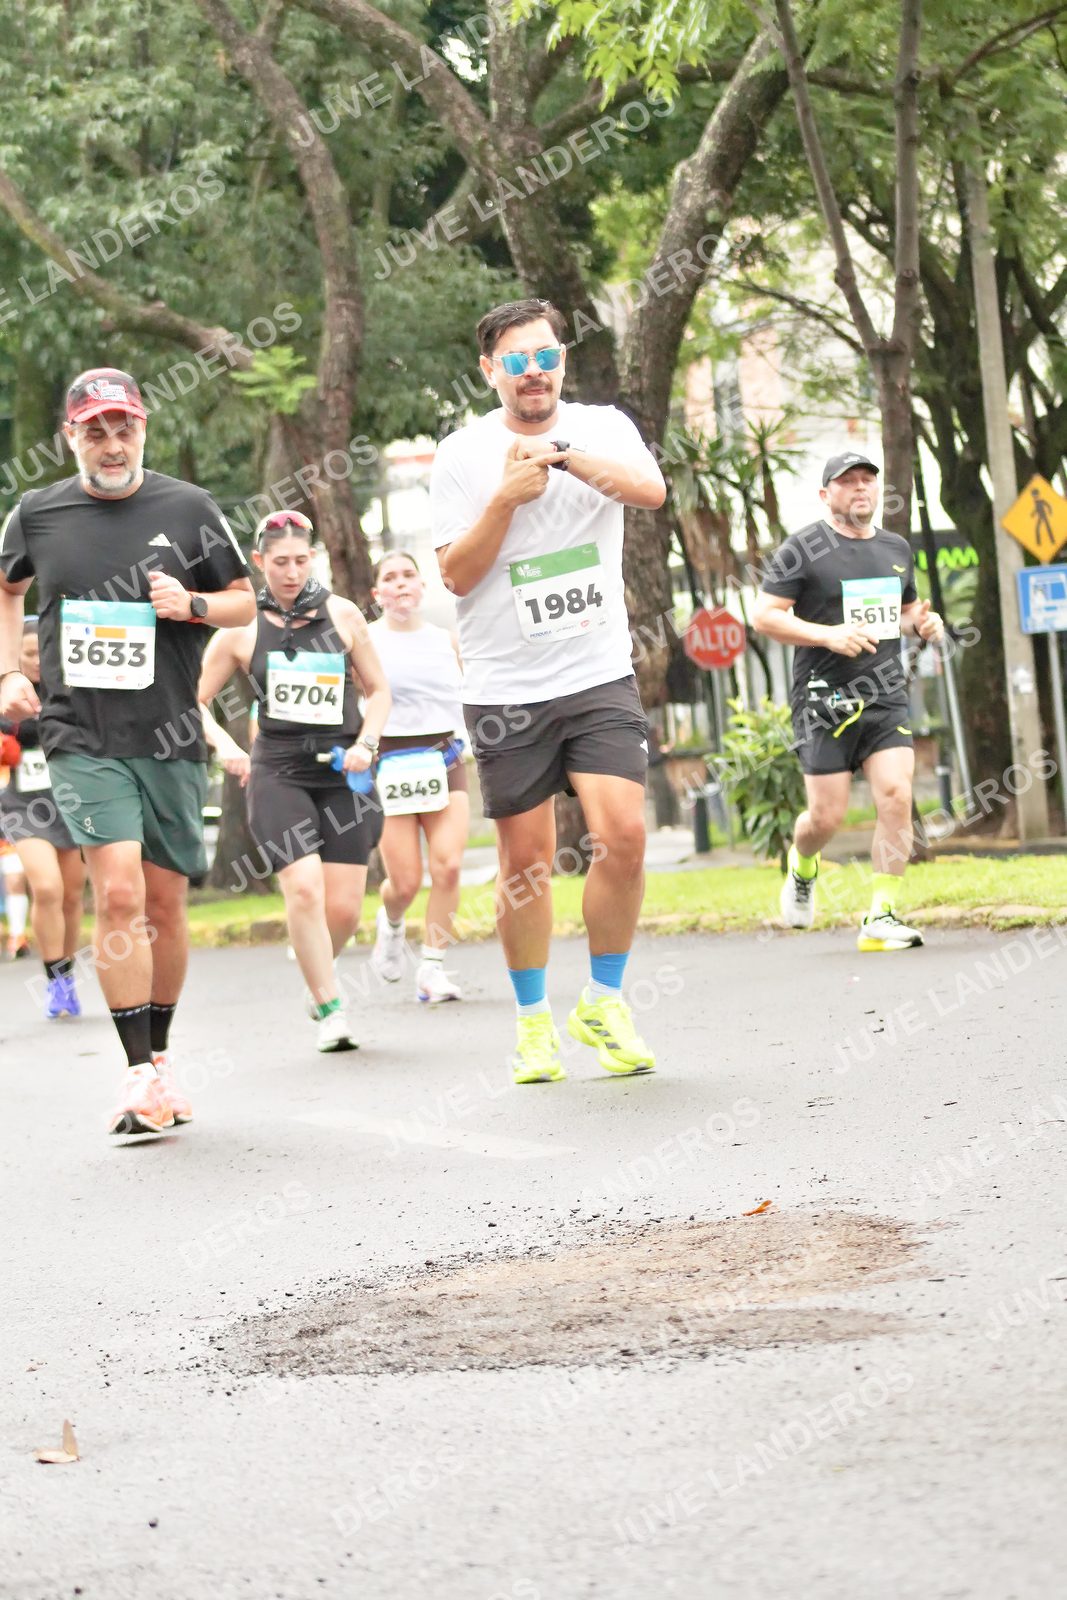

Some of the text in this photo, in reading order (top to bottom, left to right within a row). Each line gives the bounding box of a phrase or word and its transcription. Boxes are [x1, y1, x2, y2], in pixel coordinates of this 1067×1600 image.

[525, 583, 603, 624] 1984
[850, 606, 898, 624] 5615
[692, 624, 741, 653] ALTO
[68, 639, 146, 667] 3633
[275, 684, 337, 706] 6704
[386, 779, 441, 799] 2849
